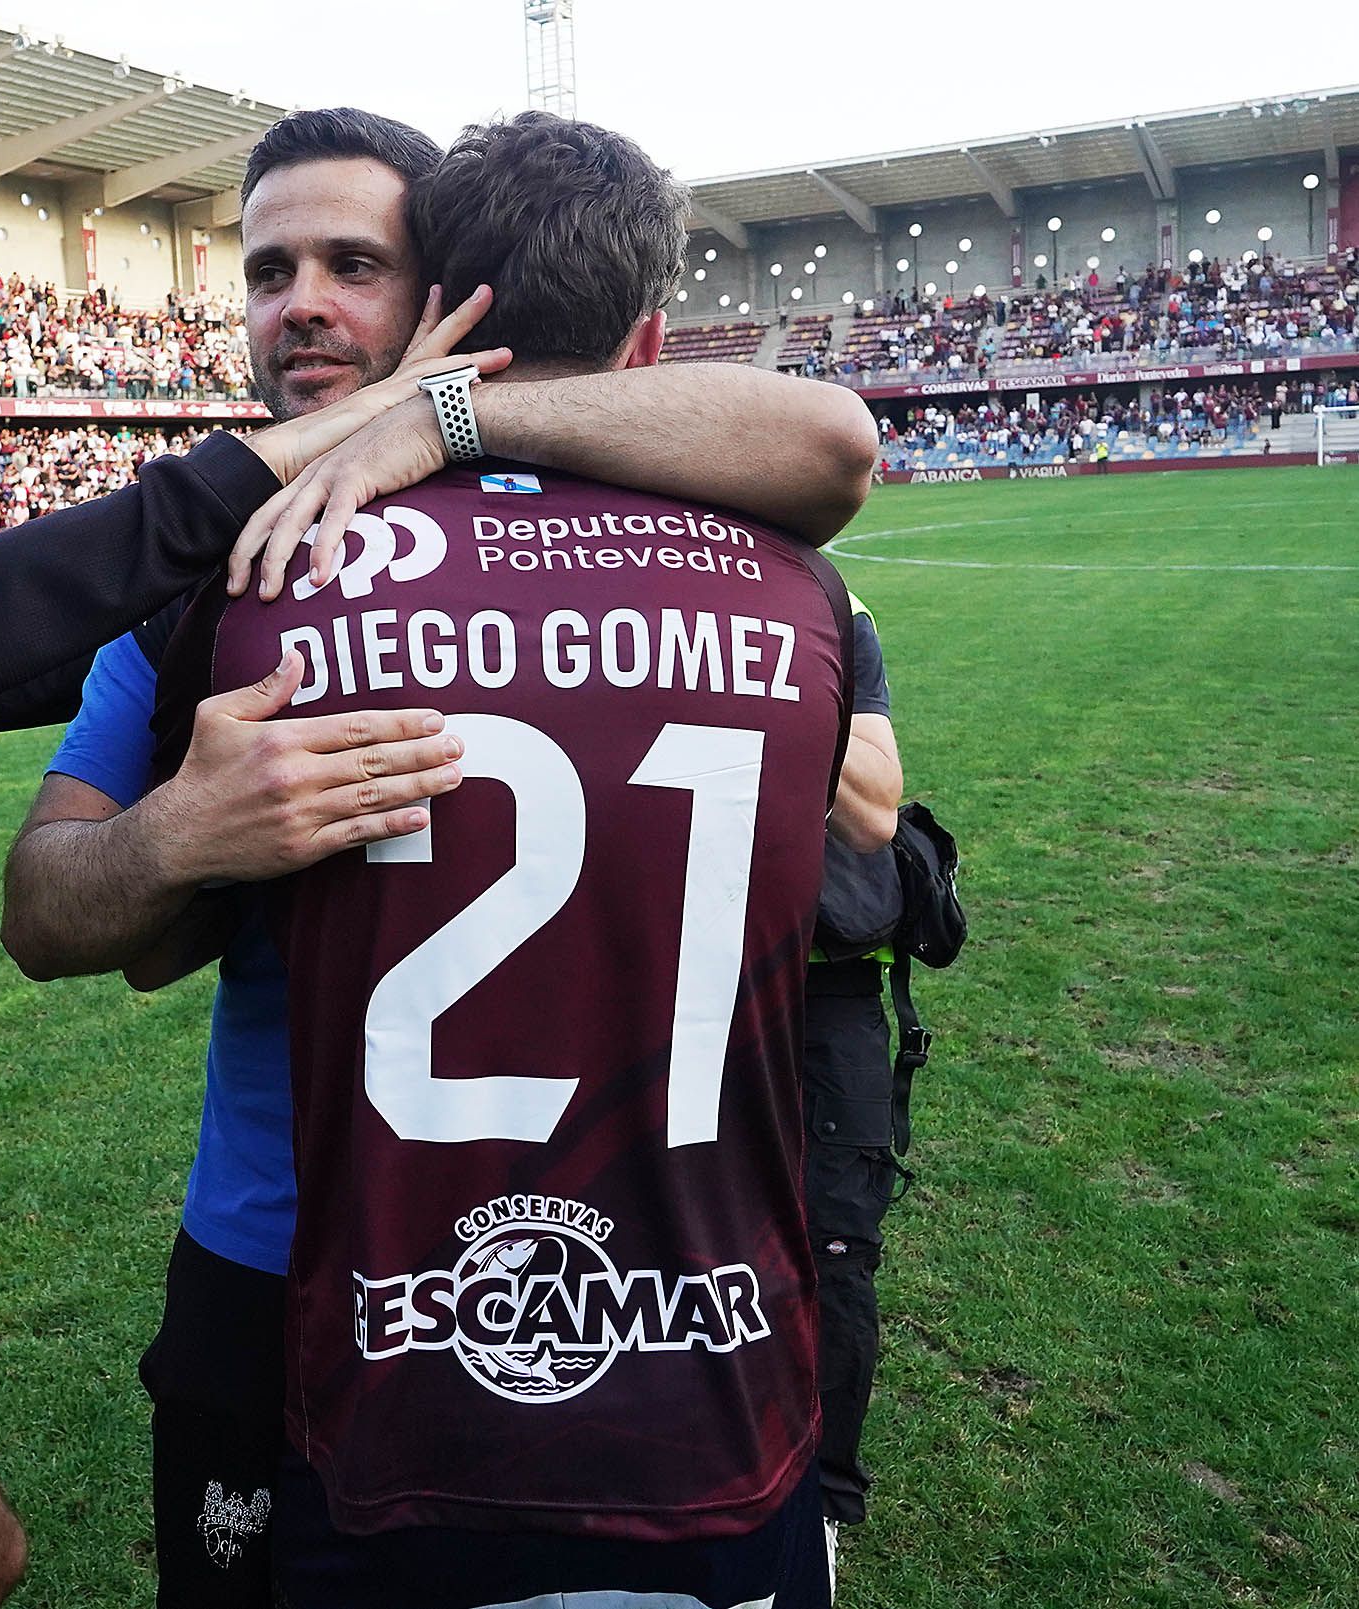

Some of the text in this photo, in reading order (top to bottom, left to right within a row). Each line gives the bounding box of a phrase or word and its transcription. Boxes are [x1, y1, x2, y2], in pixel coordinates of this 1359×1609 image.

[921, 375, 1066, 395] CONSERVAS PESCAMAR
[911, 469, 982, 484] ABANCA
[1019, 466, 1067, 479] VIAQUA
[472, 511, 755, 550] Deputación
[476, 546, 763, 582] Pontevedra
[280, 608, 800, 706] DIEGO GOMEZ
[364, 713, 766, 1149] 21
[455, 1194, 614, 1242] CONSERVAS
